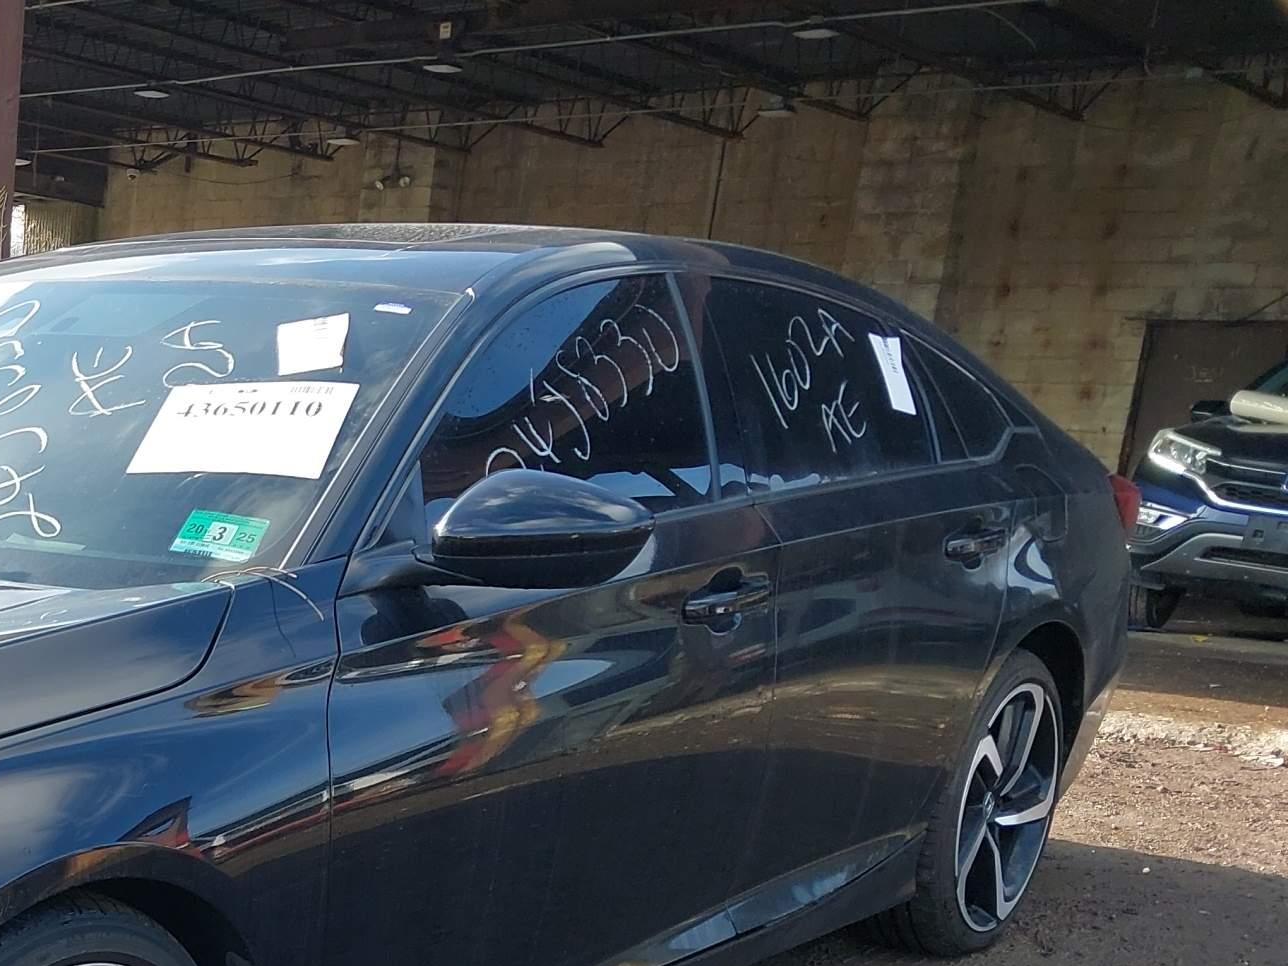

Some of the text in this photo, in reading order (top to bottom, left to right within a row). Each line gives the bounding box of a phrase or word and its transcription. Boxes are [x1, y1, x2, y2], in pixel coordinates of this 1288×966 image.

[176, 400, 323, 418] 43650110
[187, 523, 256, 543] 20 3 25
